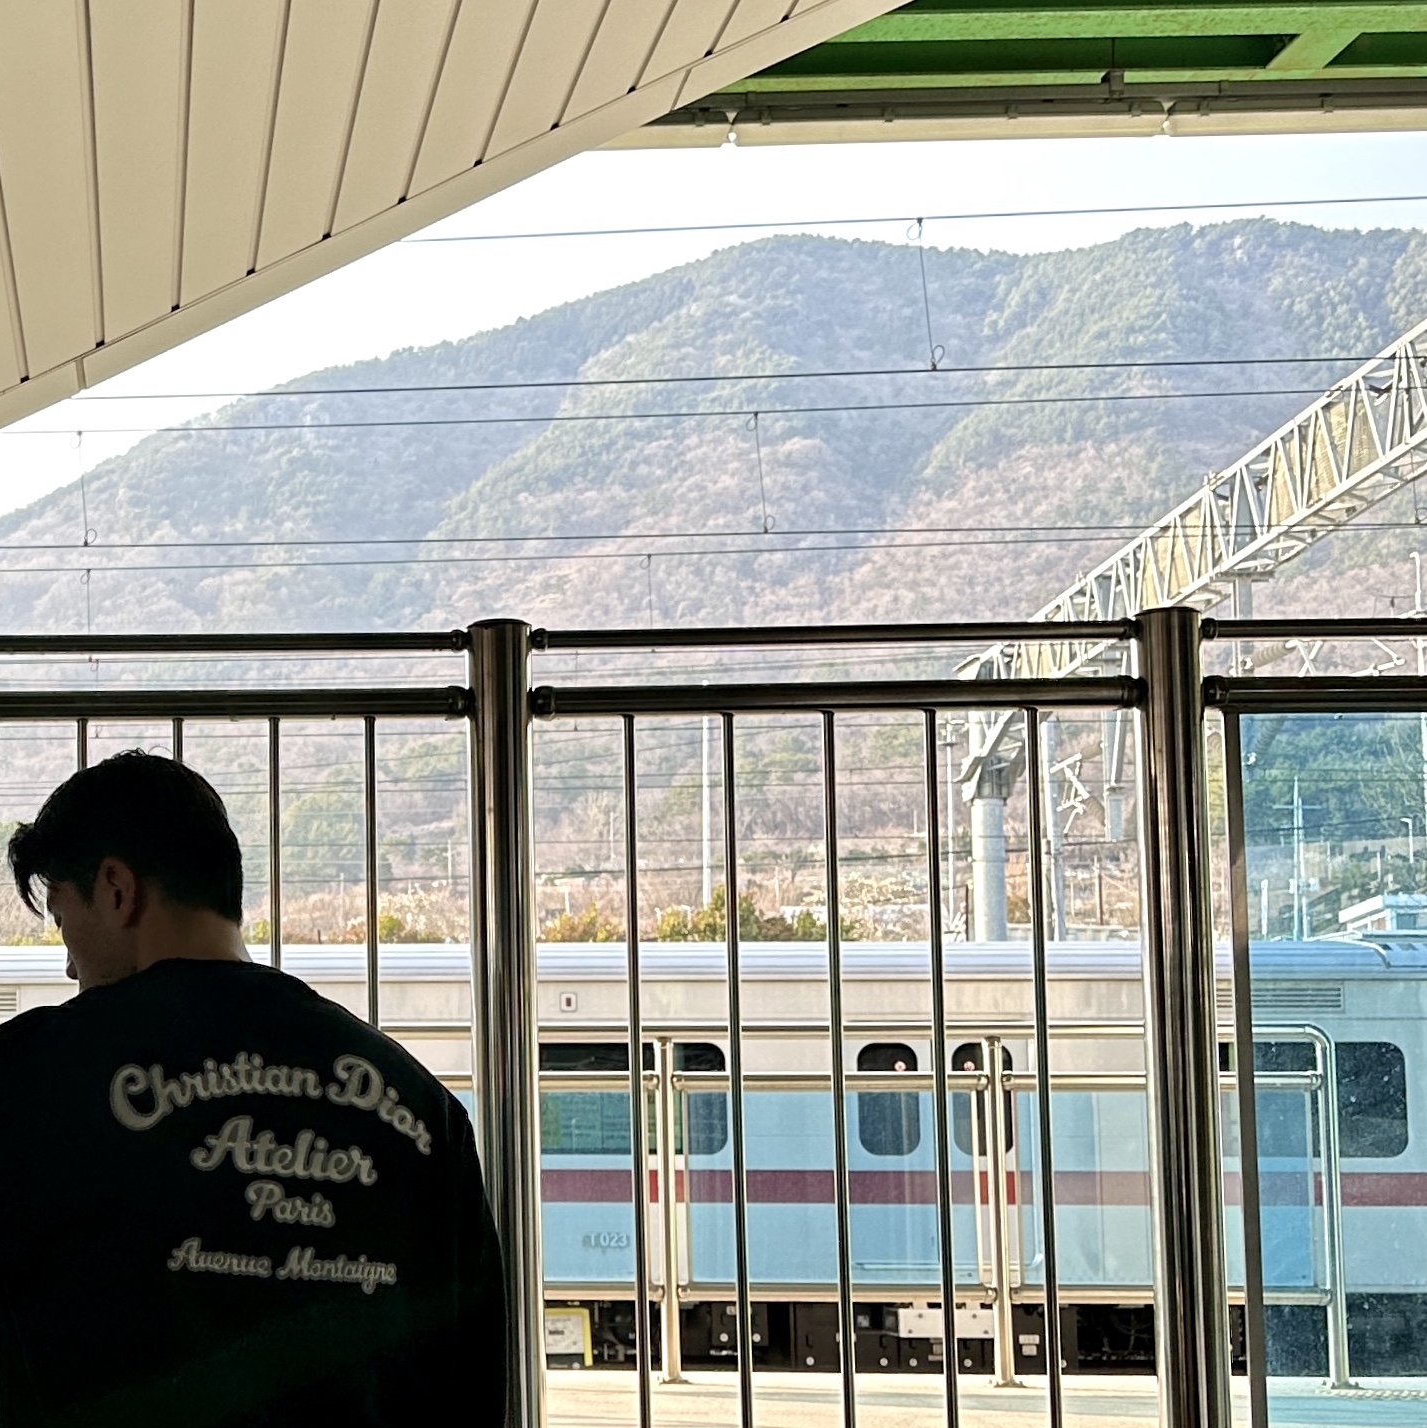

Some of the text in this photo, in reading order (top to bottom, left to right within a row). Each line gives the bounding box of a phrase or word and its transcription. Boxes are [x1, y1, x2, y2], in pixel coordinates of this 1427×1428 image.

[109, 1051, 431, 1155] Christian Dior
[190, 1115, 378, 1186] Atelier
[244, 1180, 336, 1228] Paris
[167, 1237, 397, 1294] Avenue Montaigne
